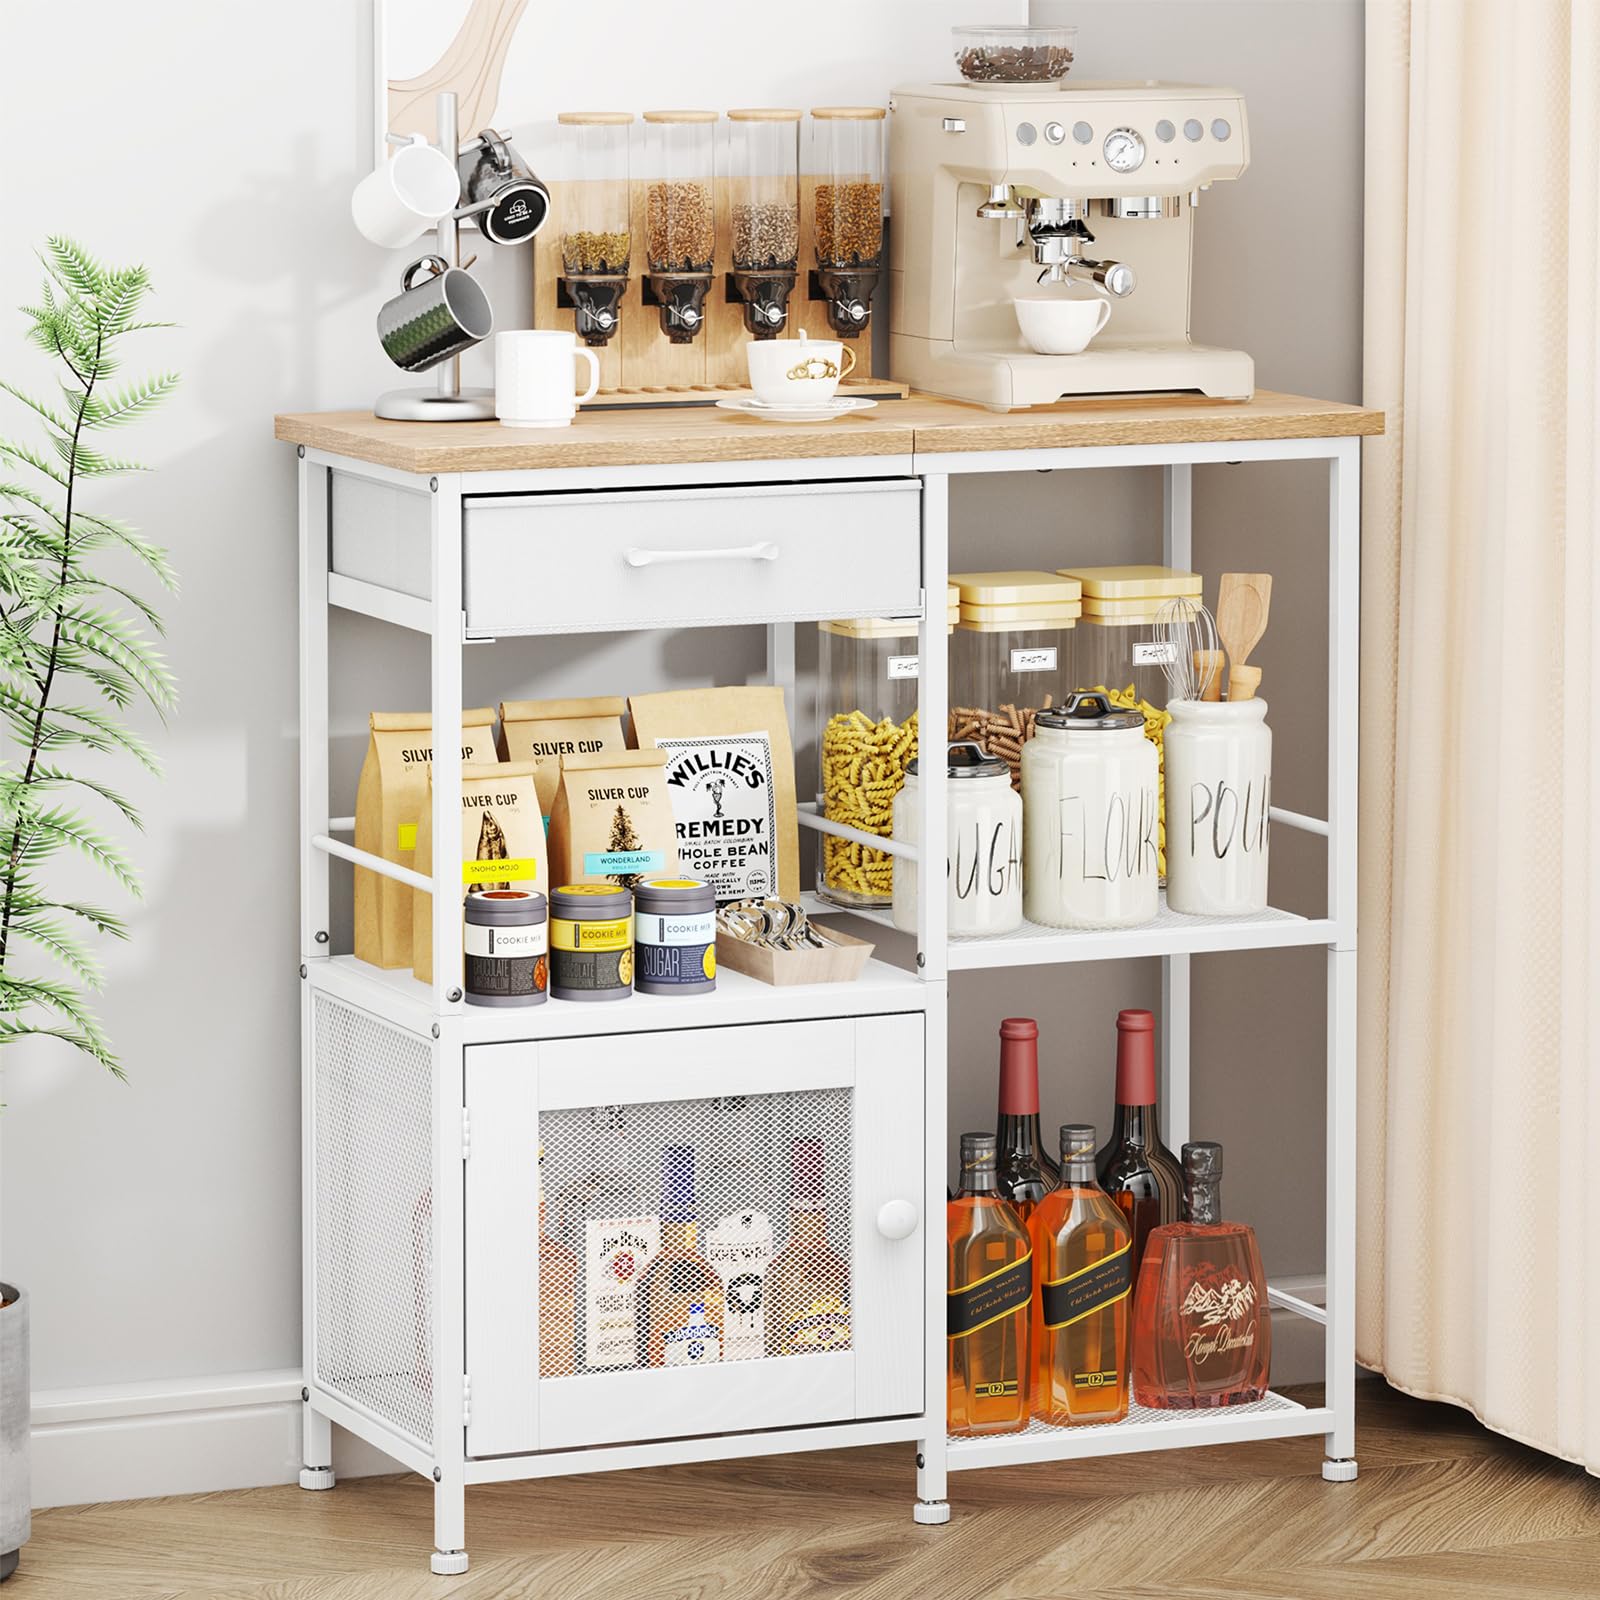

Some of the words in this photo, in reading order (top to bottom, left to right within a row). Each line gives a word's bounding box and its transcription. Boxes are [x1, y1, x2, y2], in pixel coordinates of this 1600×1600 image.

[402, 748, 432, 762] SILVE
[533, 742, 575, 756] SILVER
[579, 741, 604, 753] CUP
[667, 750, 765, 789] WILLIE'S
[462, 795, 493, 807] ILVER
[495, 793, 518, 806] CUP
[587, 788, 625, 801] SILVER
[627, 786, 650, 799] CUP
[1191, 774, 1270, 860] POU
[727, 841, 768, 857] BEAN
[600, 856, 651, 865] WONDERLAND
[693, 859, 746, 870] COFFEE
[470, 865, 497, 873] SNOHO
[498, 863, 519, 872] MOJO
[666, 925, 698, 933] COOKIE
[496, 936, 529, 945] COOKIE
[643, 946, 680, 976] SUGAR
[1091, 1375, 1101, 1384] 12
[991, 1385, 1001, 1394] 12
